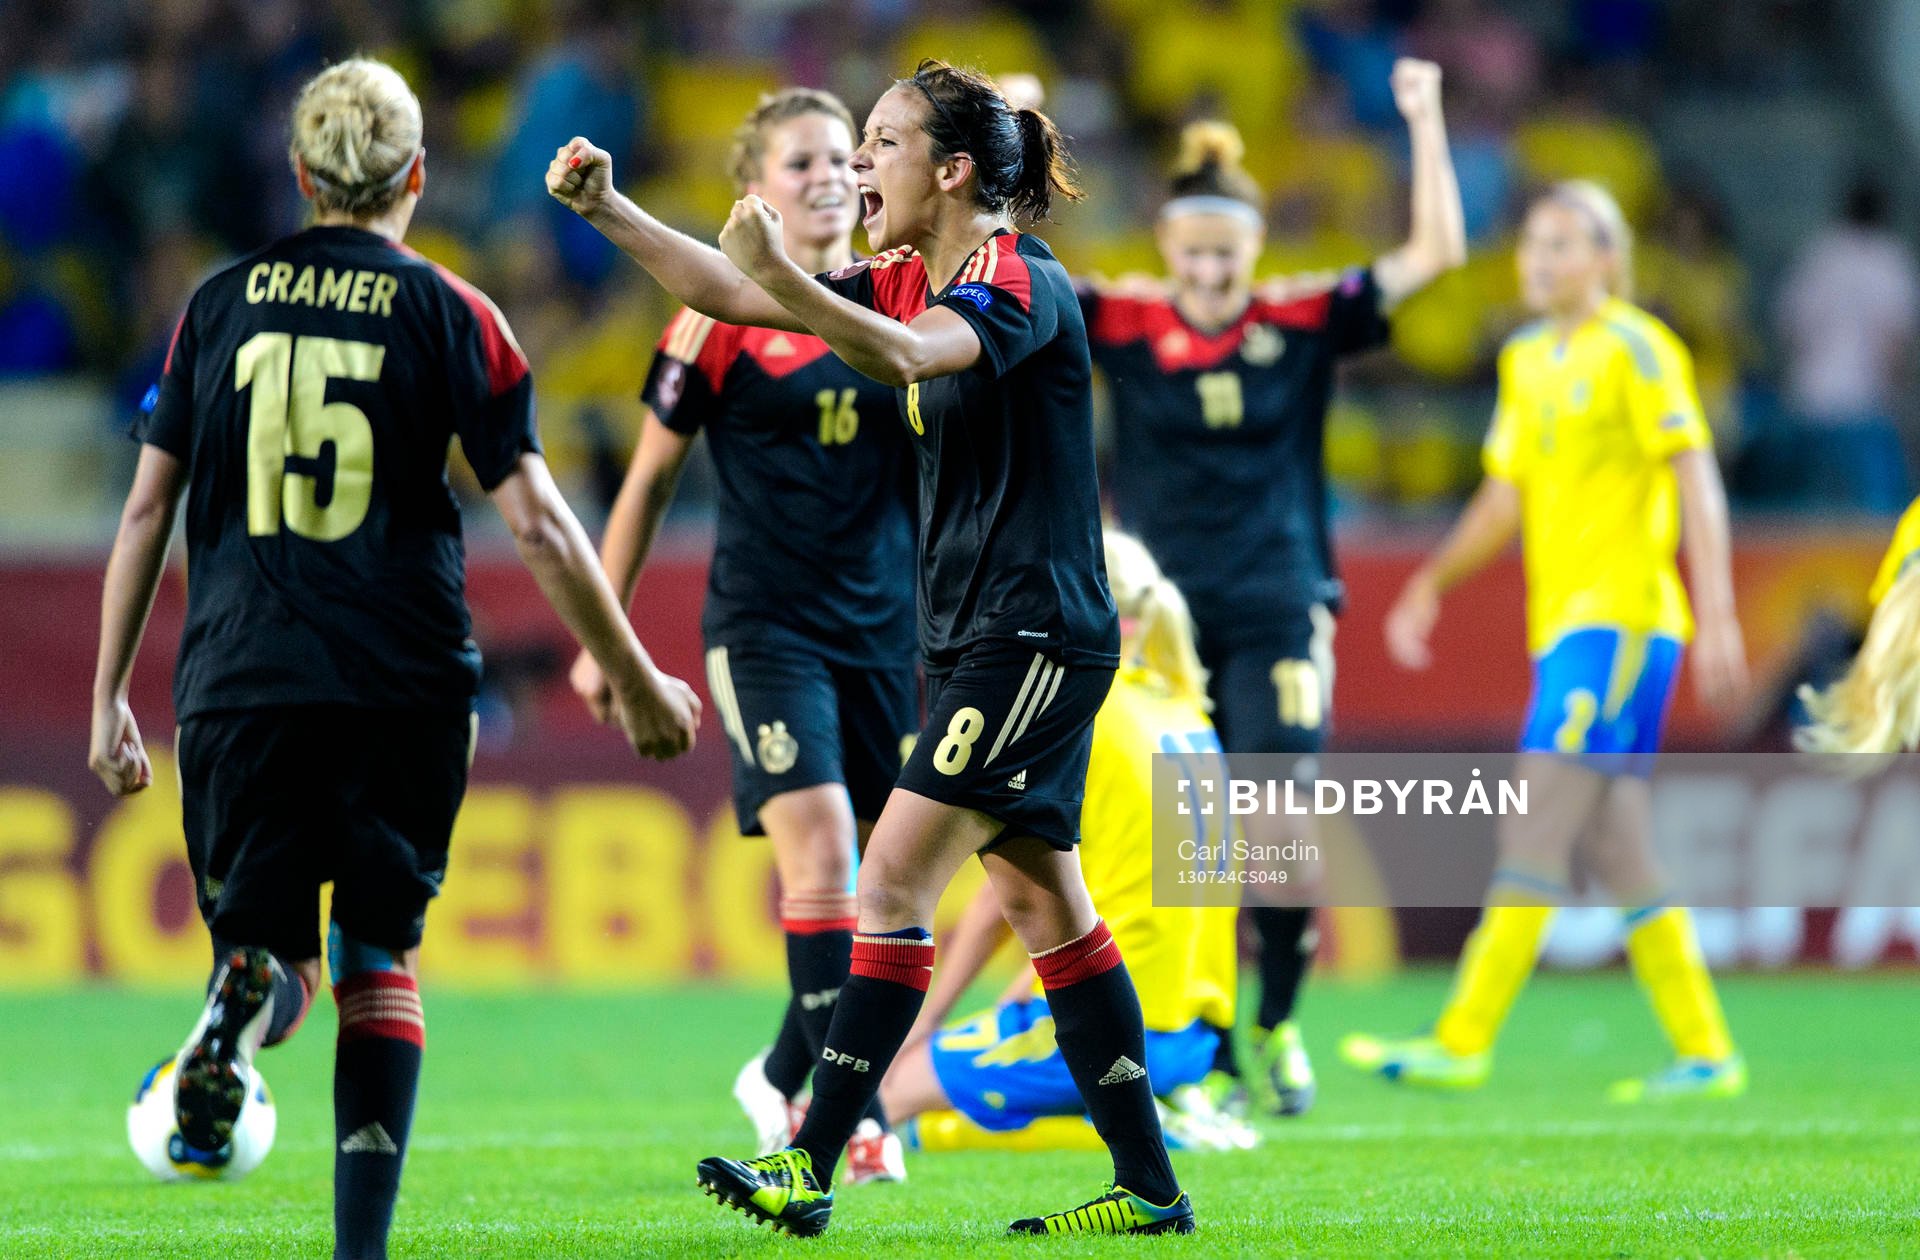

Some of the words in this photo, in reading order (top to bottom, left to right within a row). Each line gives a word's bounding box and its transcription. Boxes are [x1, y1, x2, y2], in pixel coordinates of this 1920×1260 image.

[245, 261, 398, 318] CRAMER
[234, 331, 386, 543] 15
[815, 387, 859, 446] 16
[932, 706, 985, 776] 8
[822, 1046, 870, 1073] DFB
[1098, 1067, 1146, 1086] adidas
